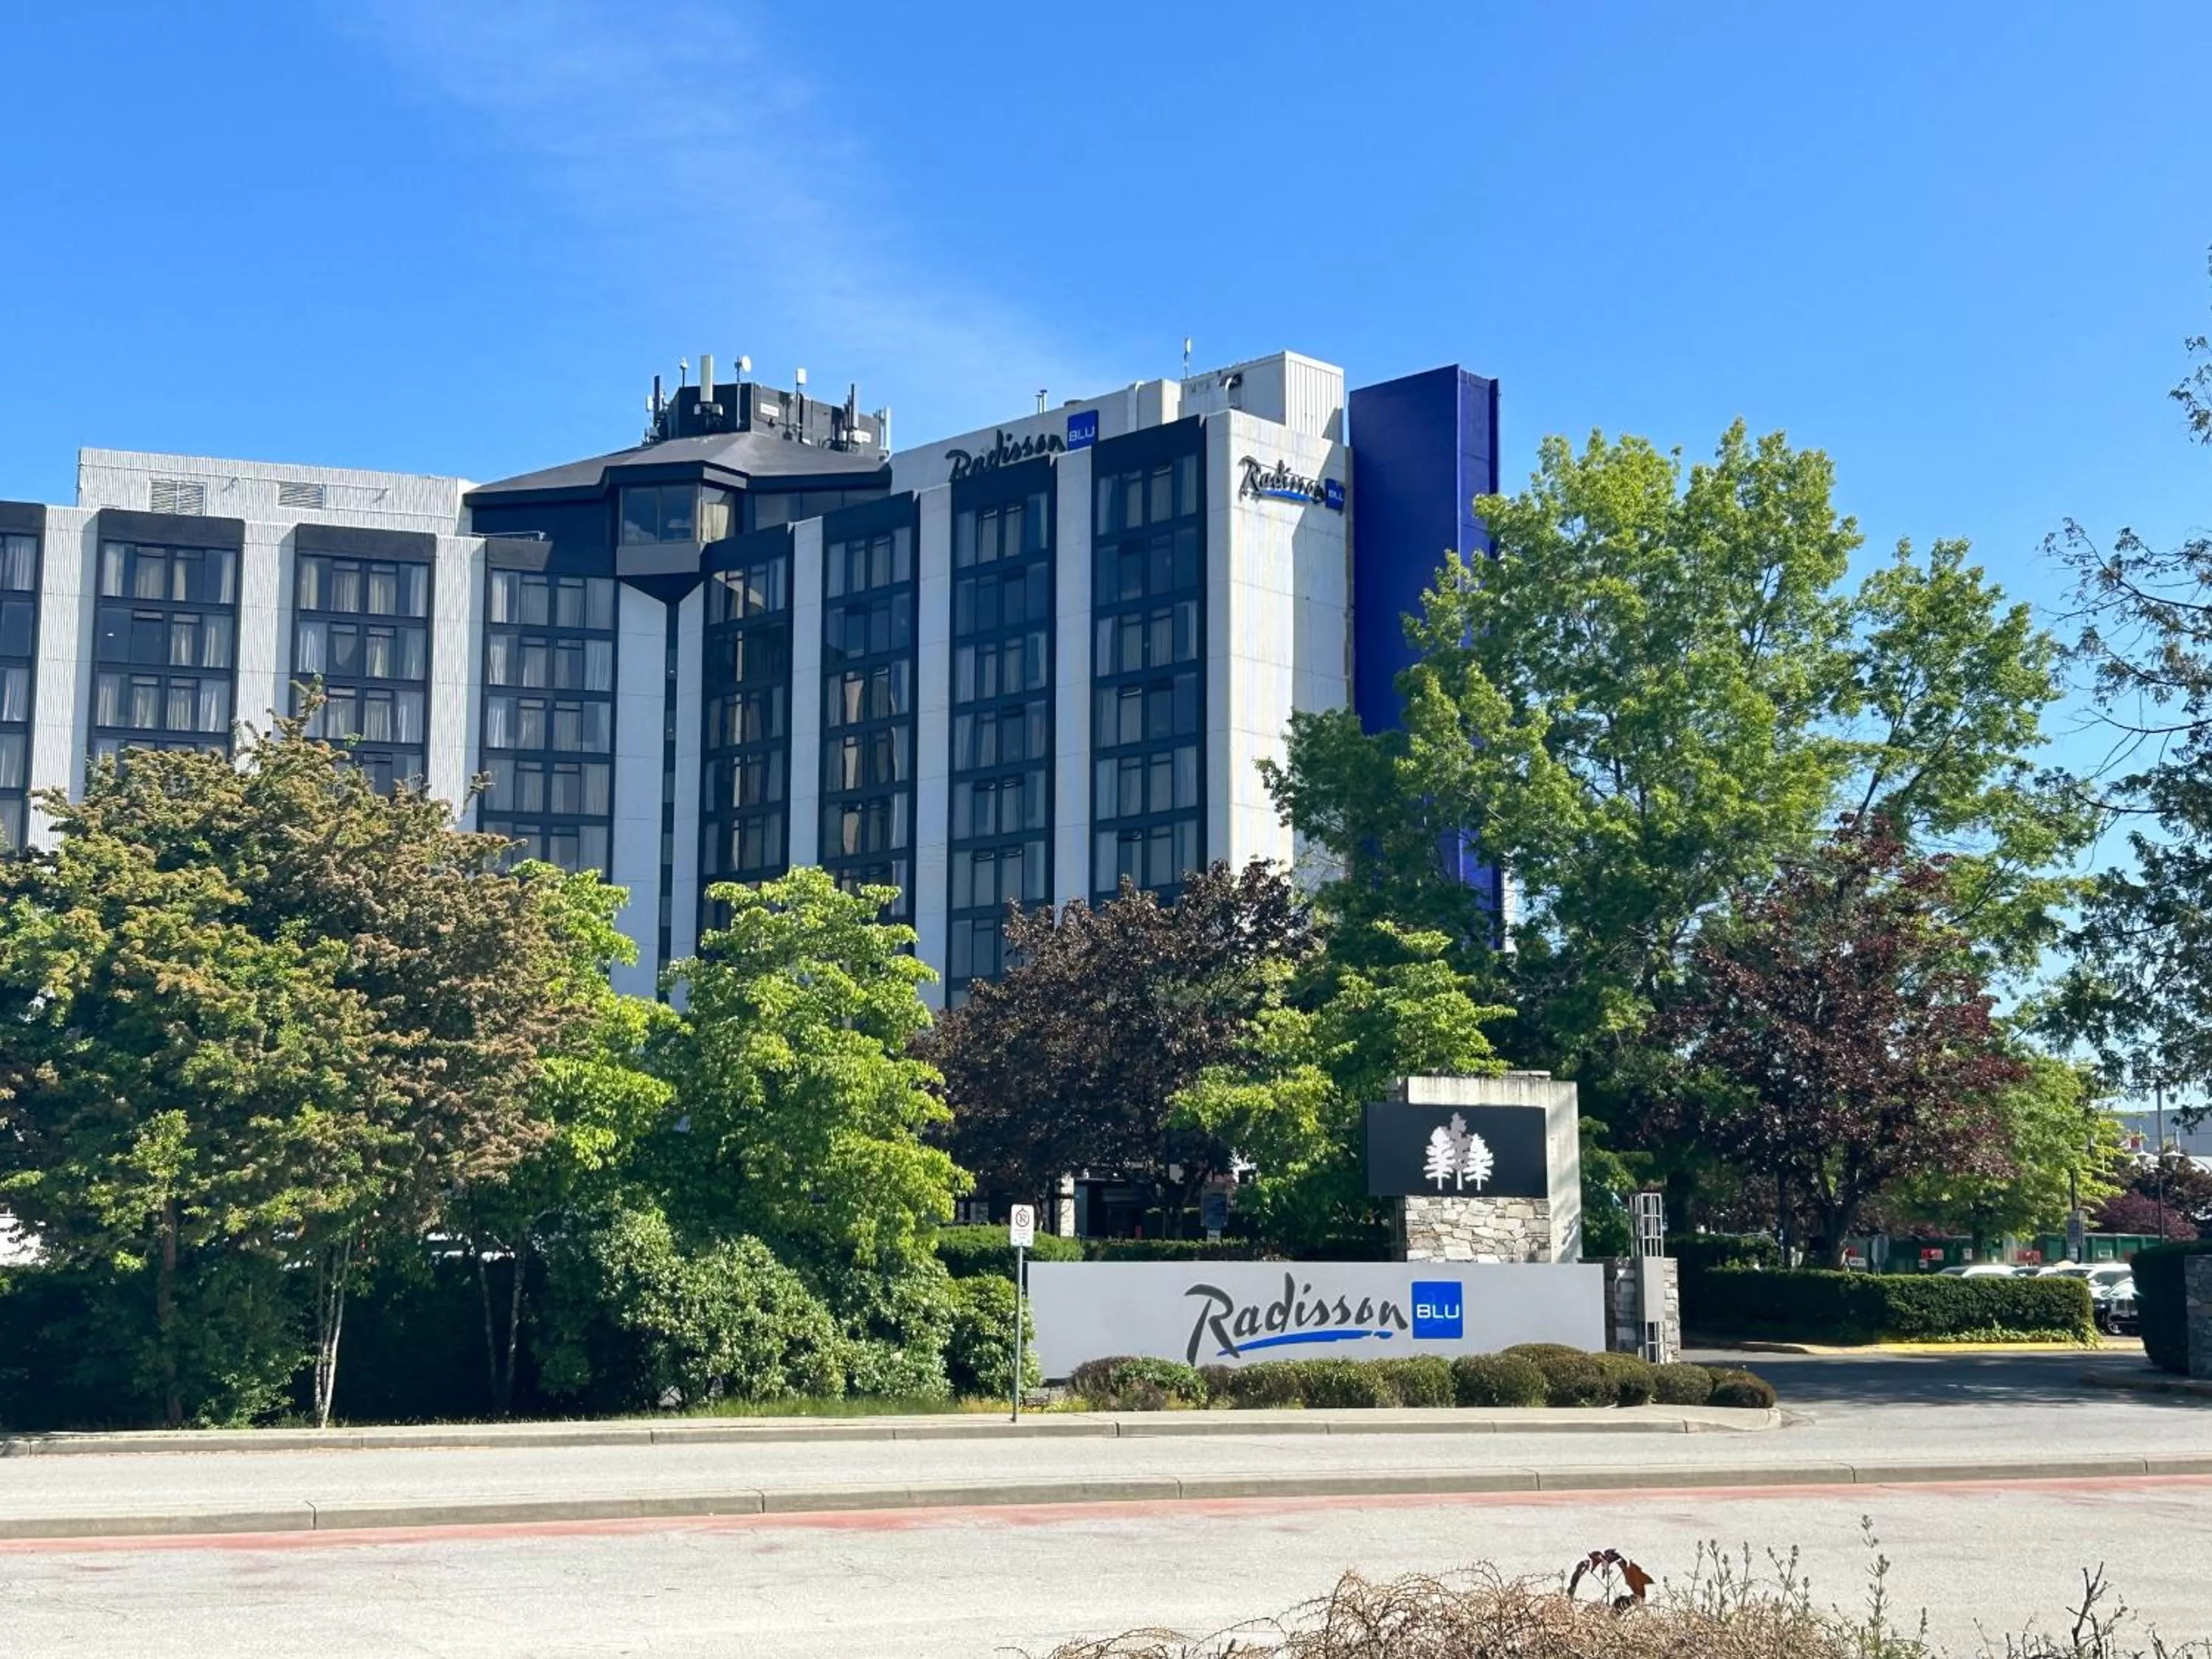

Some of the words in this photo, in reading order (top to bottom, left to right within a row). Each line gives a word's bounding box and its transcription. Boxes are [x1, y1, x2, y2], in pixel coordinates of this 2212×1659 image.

[945, 428, 1066, 483] Radisson
[1068, 425, 1095, 442] BLU
[1184, 1272, 1409, 1367] Radisson
[1416, 1304, 1460, 1319] BLU
